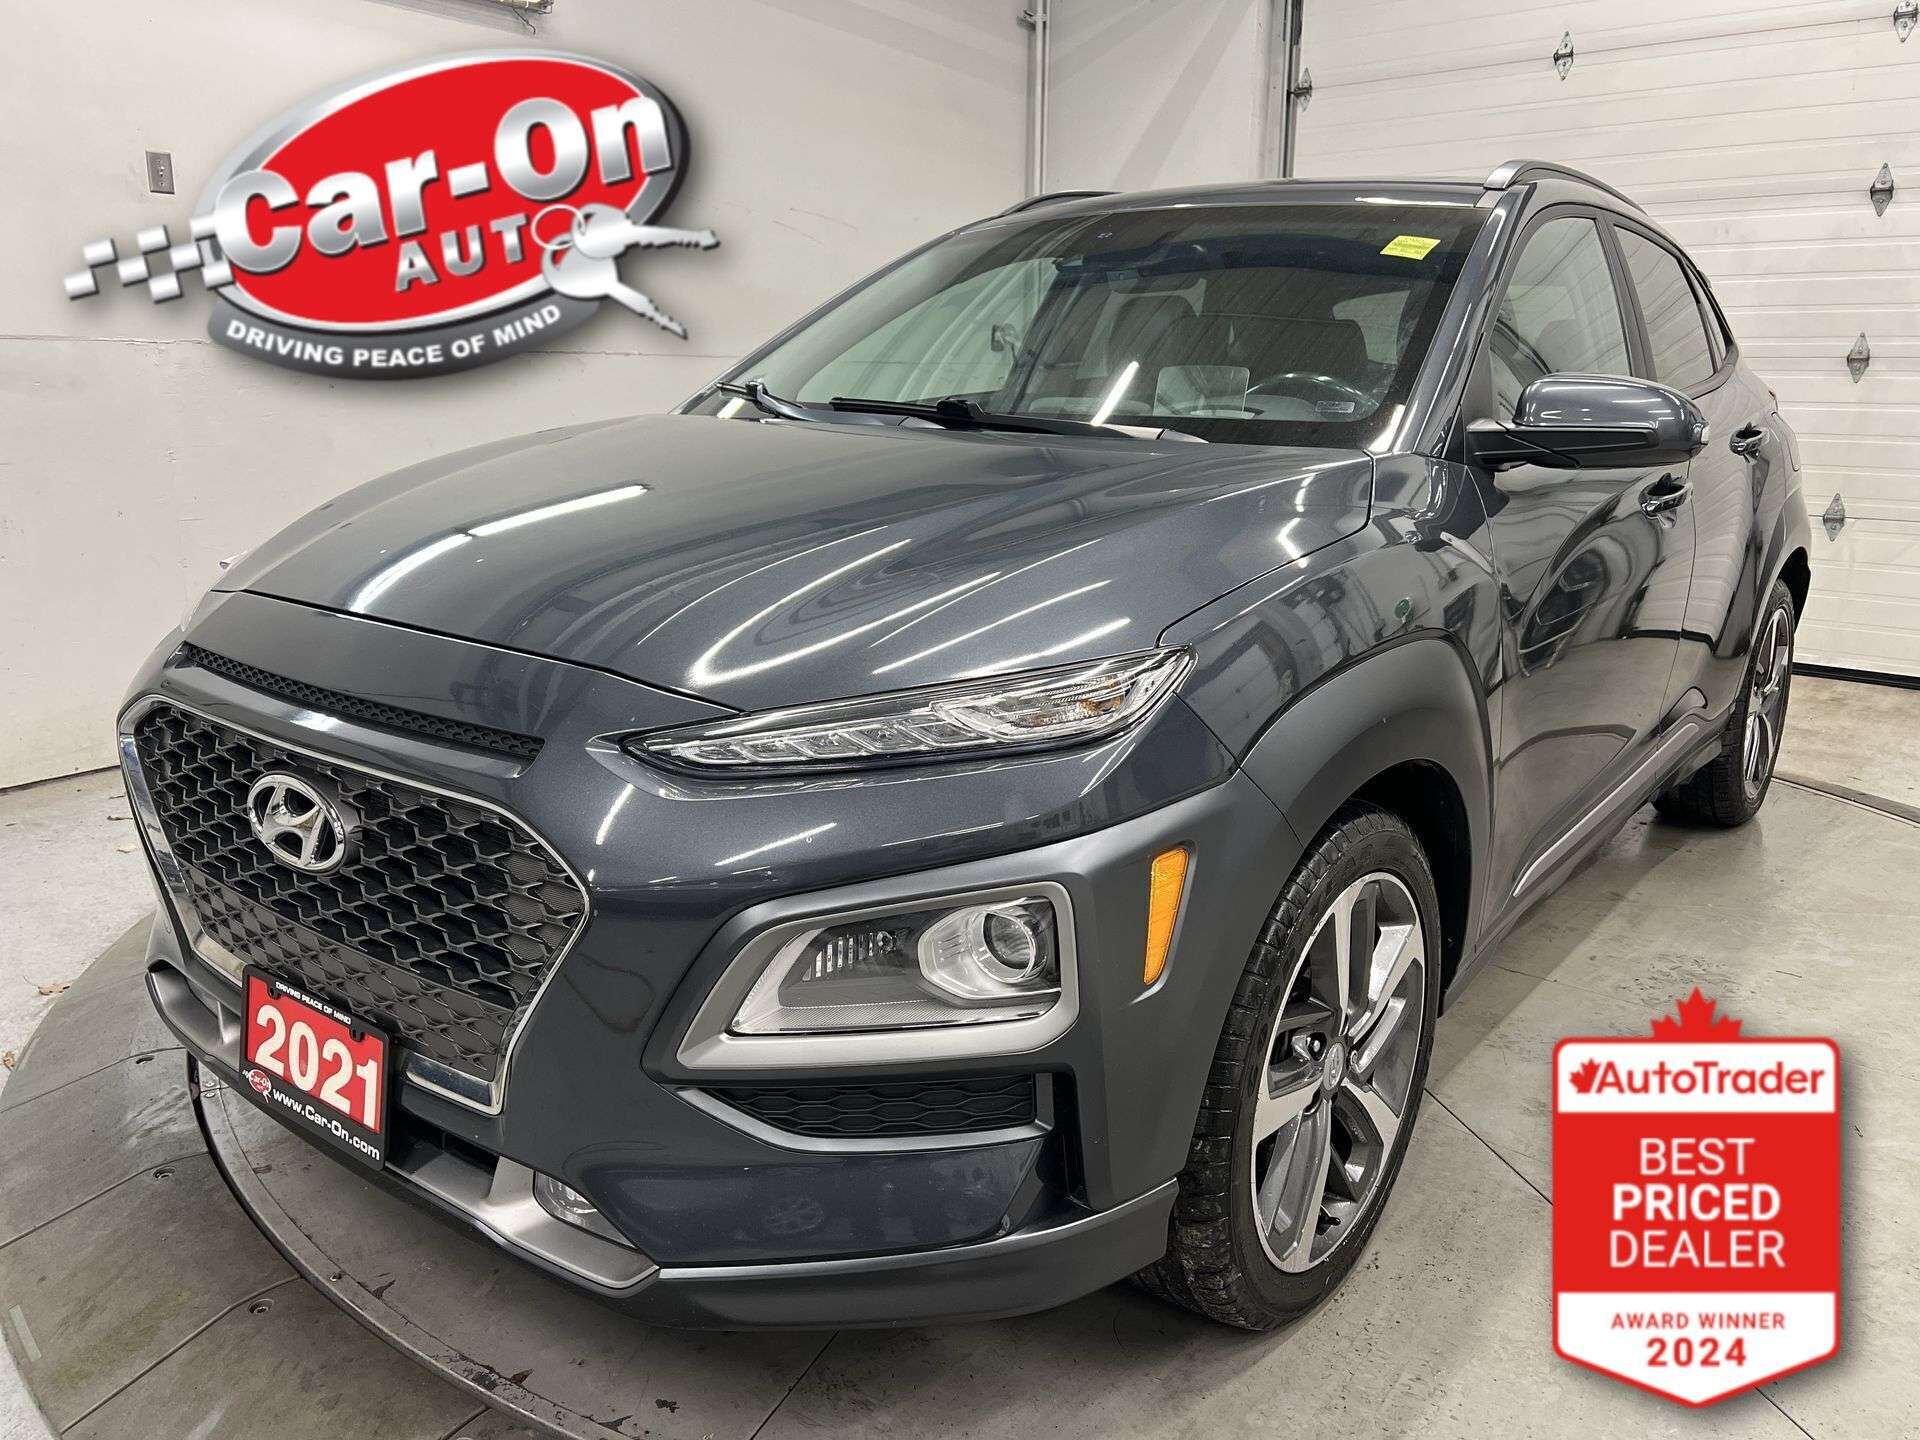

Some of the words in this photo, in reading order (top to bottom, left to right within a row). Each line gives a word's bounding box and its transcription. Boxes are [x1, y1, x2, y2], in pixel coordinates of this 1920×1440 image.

[275, 981, 301, 1000] DRIVING
[301, 994, 323, 1011] PEACE
[323, 1005, 333, 1015] OF
[333, 1010, 352, 1025] MIND
[255, 1004, 378, 1131] 2021
[273, 1088, 381, 1160] www.Car-On.com
